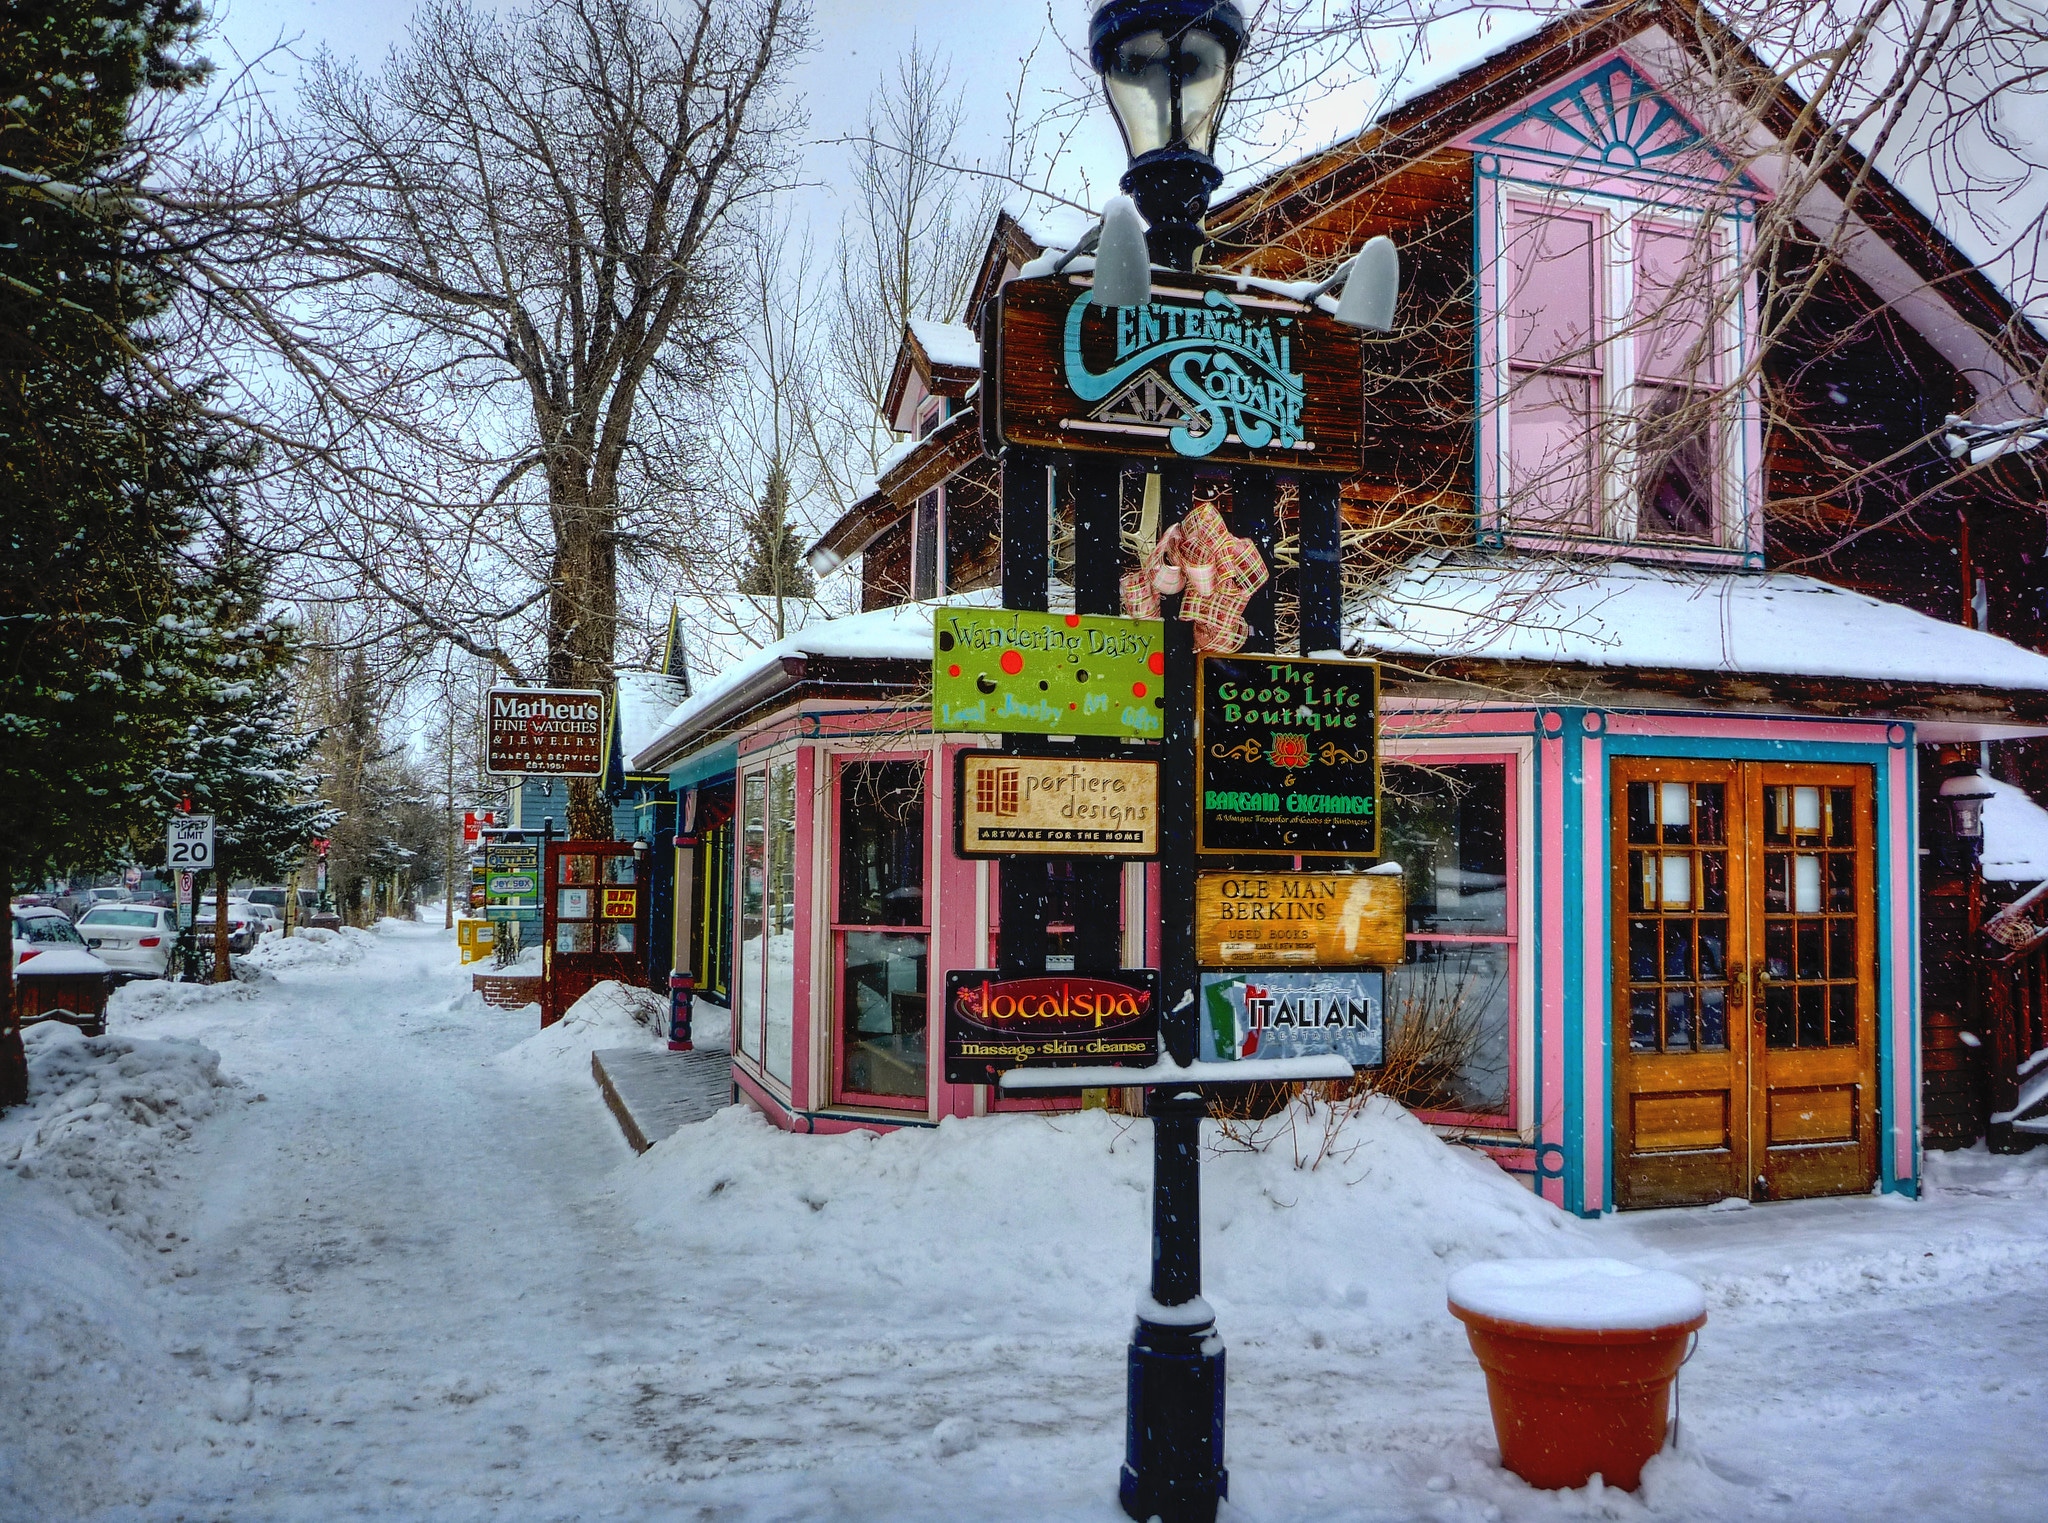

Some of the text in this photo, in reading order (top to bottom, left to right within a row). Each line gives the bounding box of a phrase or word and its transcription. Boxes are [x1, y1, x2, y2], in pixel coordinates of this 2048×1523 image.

[1169, 351, 1305, 458] SQUARE
[949, 613, 1154, 664] Wandering Daisy
[1266, 663, 1315, 685] The
[1218, 682, 1361, 708] Good Life
[493, 697, 599, 720] Matheu's
[1222, 703, 1358, 732] Boutique
[494, 720, 597, 733] FINE WATCHES
[493, 735, 597, 746] & JEWELRY
[491, 752, 599, 762] SALES & SERVICE
[1025, 765, 1127, 801] portiera
[1284, 773, 1297, 788] &
[1205, 790, 1374, 815] BARGAIN EXCHANGE
[1060, 795, 1149, 831] designs
[177, 831, 205, 840] LIMIT
[981, 829, 1141, 842] ARTWARE FOR THE HOME
[172, 842, 208, 862] 20
[488, 855, 537, 866] OUTLET
[494, 879, 530, 888] JOY SOX
[1222, 879, 1338, 899] OLE MAN
[619, 890, 635, 901] BUY
[605, 903, 634, 916] GOLD
[1220, 902, 1328, 921] BERKINS
[1229, 929, 1310, 940] USED BOOKS
[981, 978, 1141, 1028] localspa
[1248, 995, 1372, 1030] ITALIAN
[1266, 1030, 1378, 1042] RESTAURANT
[961, 1039, 1147, 1062] massage skin cleanse
